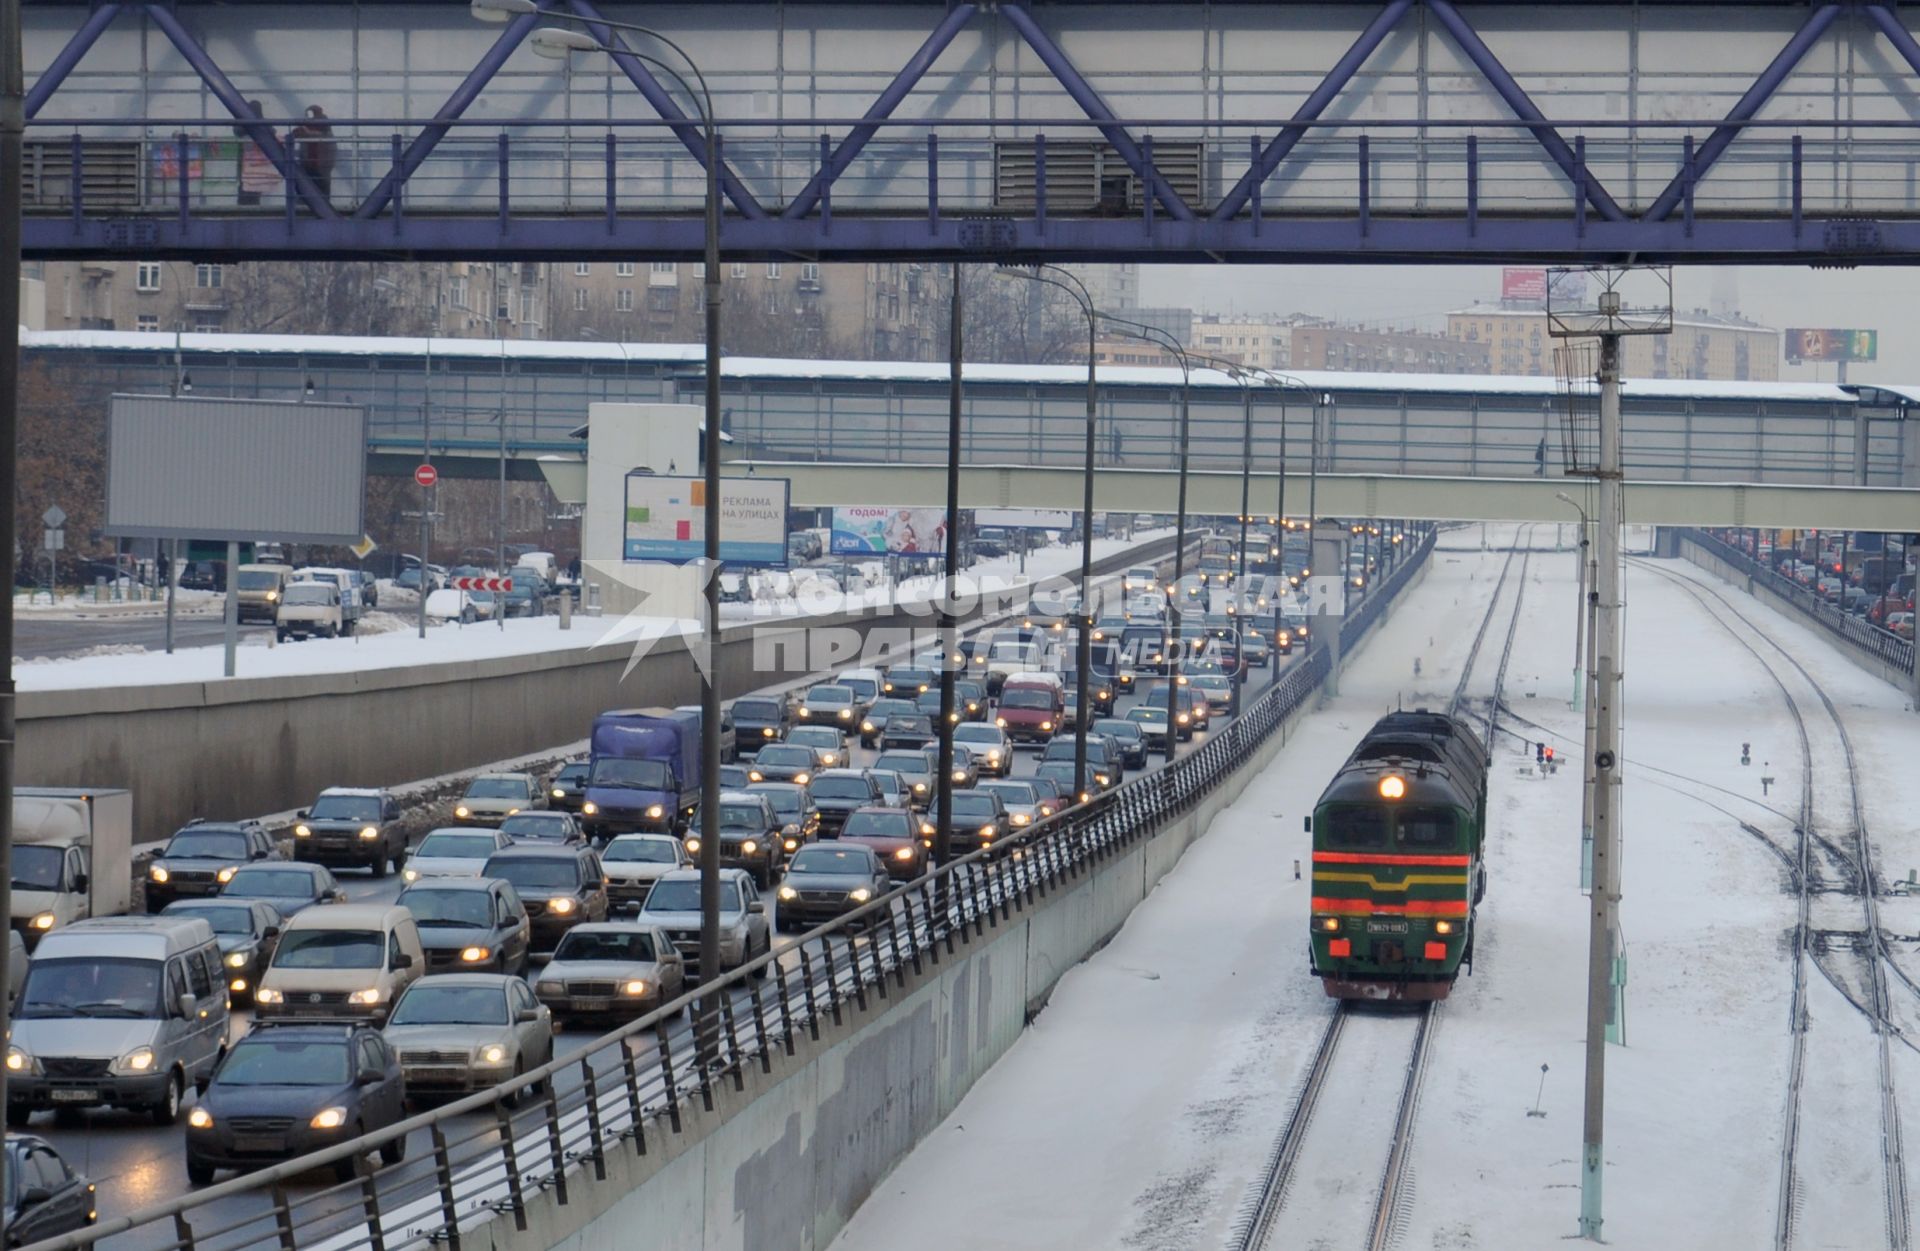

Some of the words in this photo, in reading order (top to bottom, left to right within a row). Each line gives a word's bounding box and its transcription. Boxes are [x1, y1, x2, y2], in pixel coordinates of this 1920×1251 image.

[722, 496, 771, 506] РЕКЛАМА
[722, 509, 737, 519] НА
[738, 509, 779, 520] УЛИЦАХ
